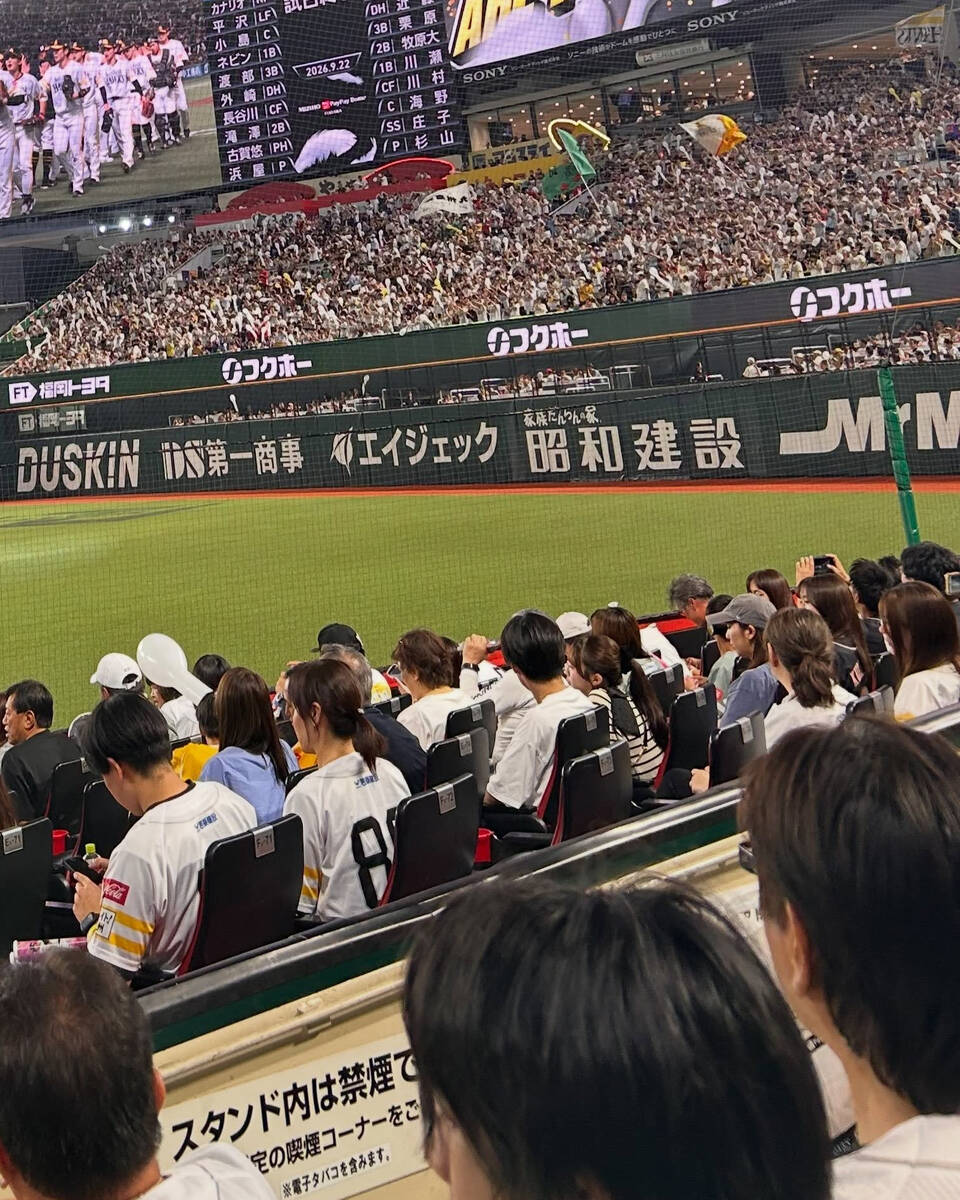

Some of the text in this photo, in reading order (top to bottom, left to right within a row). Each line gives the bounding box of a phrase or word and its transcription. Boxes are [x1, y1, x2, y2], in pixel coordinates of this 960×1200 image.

[258, 10, 271, 22] LF
[370, 3, 386, 15] DH
[373, 22, 388, 34] 3B
[687, 9, 739, 32] SONY
[263, 29, 271, 40] C
[376, 29, 440, 54] 2B 牧原大
[217, 47, 276, 69] ネビン 1B
[305, 59, 350, 77] 2026.9.22
[379, 61, 393, 73] 1B
[265, 65, 279, 78] 3B
[463, 65, 508, 84] SONY
[266, 84, 281, 97] DH
[381, 80, 395, 93] CF
[223, 103, 282, 126] 長谷川 CF
[387, 101, 395, 112] C
[271, 122, 285, 134] 2B
[386, 120, 401, 132] SS
[226, 140, 288, 163] 古賀悠 PH
[392, 141, 400, 152] P
[278, 160, 286, 171] P
[816, 278, 913, 317] フクホー
[509, 321, 589, 353] フクホー
[241, 353, 313, 381] フクホー
[13, 376, 110, 400] FT 福岡トヨタ
[357, 421, 499, 467] エイジェック
[525, 417, 745, 474] 昭和建設
[206, 433, 304, 477] 第一商事
[16, 438, 140, 493] DUSKIN
[171, 1047, 420, 1163] スタンド内は禁煙で
[245, 1098, 421, 1176] 定の喫煙コーナーをご
